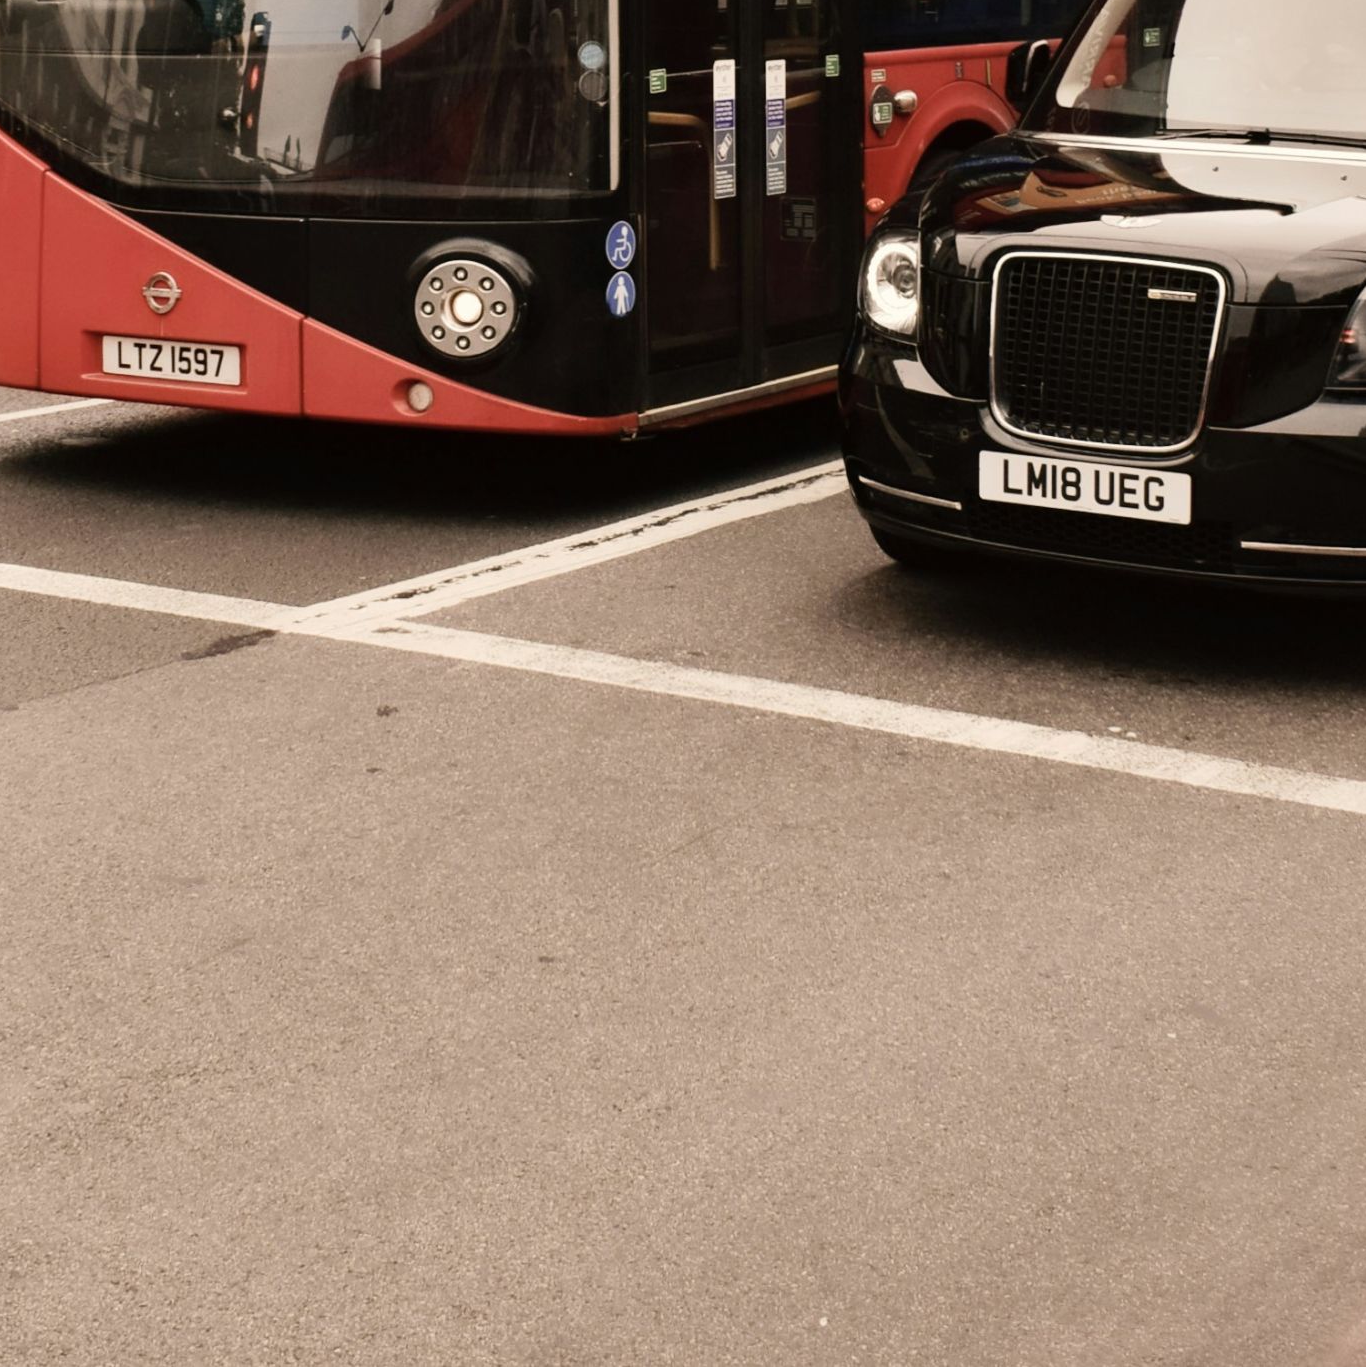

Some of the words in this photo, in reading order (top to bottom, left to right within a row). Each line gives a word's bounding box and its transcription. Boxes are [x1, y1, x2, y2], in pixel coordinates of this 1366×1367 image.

[116, 340, 164, 371] LTZ
[169, 345, 225, 378] 1597
[1002, 458, 1082, 502] LM18
[1093, 470, 1166, 512] UEG
